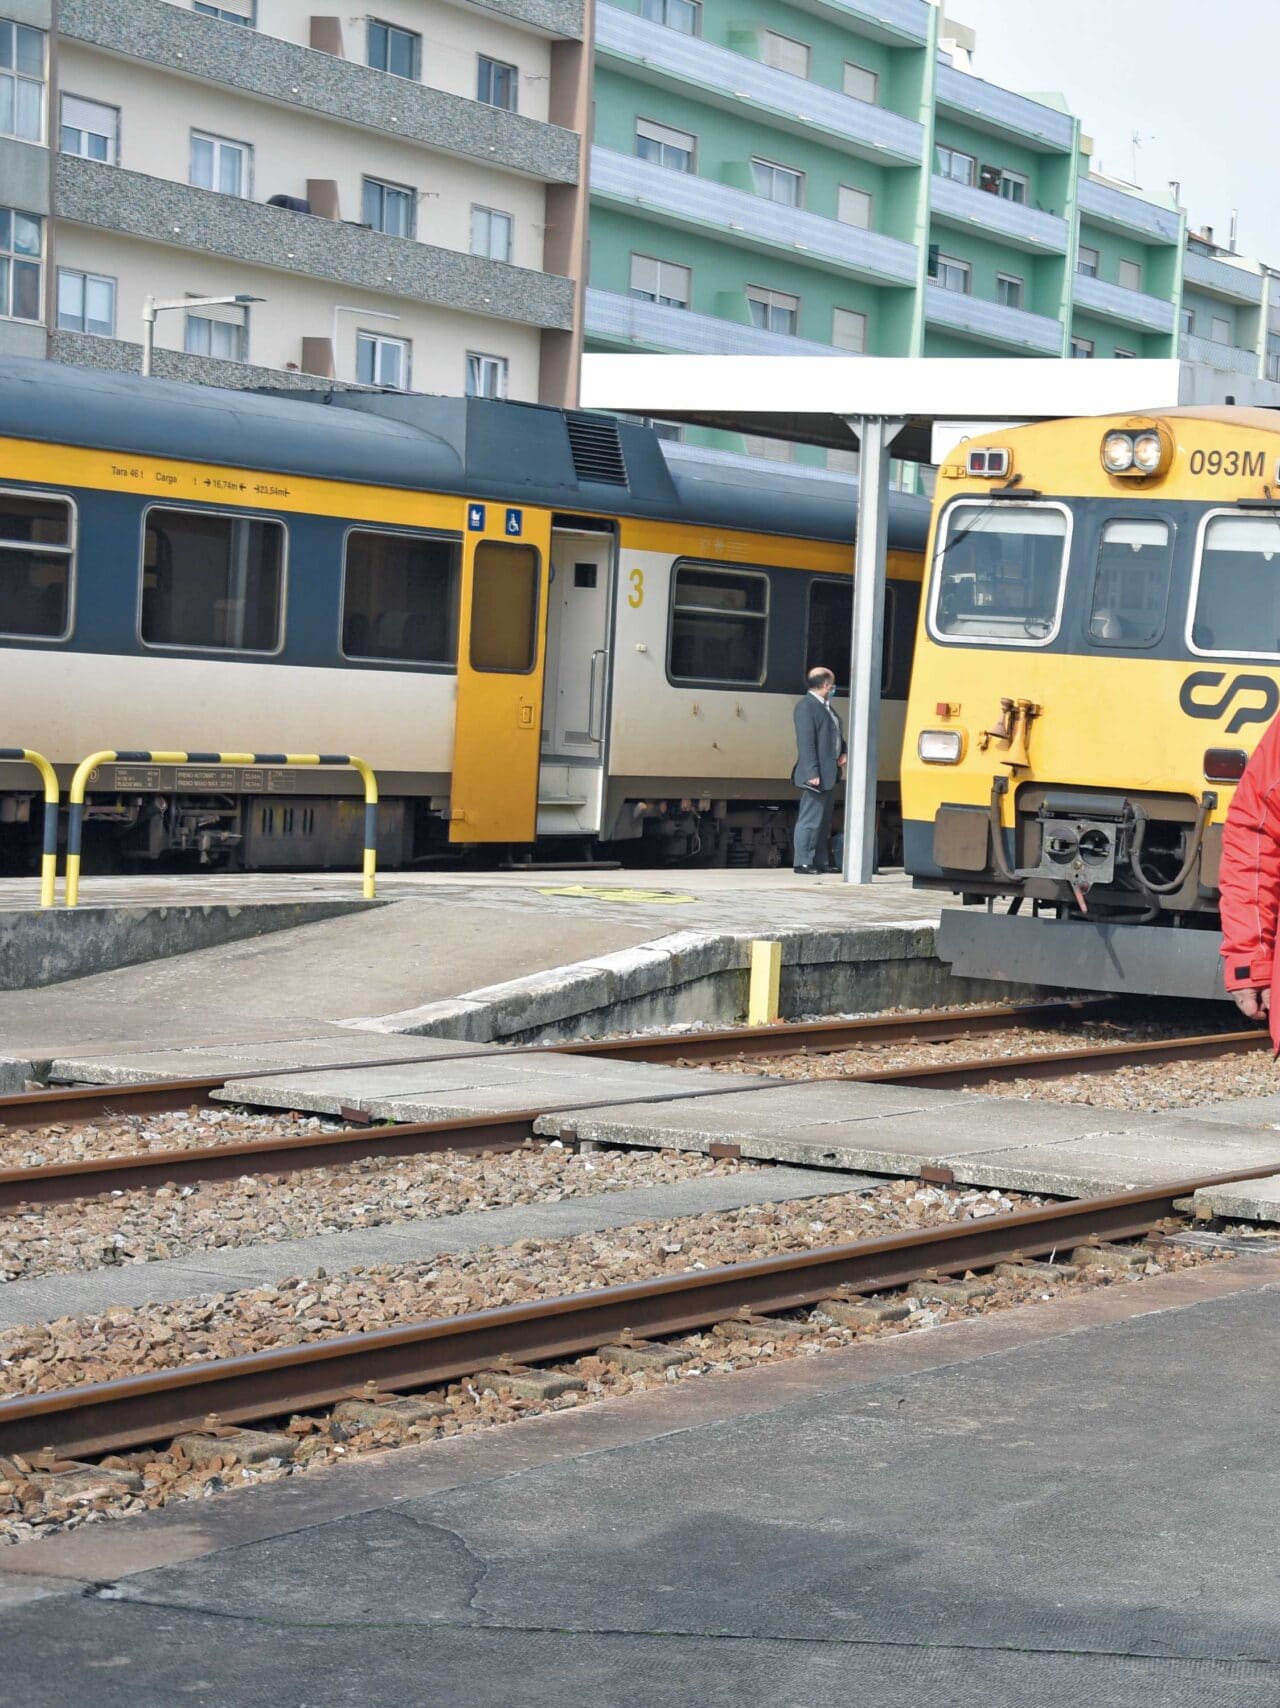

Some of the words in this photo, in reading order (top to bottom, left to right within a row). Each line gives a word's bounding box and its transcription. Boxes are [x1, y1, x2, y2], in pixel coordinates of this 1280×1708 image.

[111, 465, 128, 477] Tara
[155, 472, 177, 485] Carga
[1190, 449, 1266, 477] 093M
[628, 568, 645, 608] 3
[1179, 670, 1280, 734] CP
